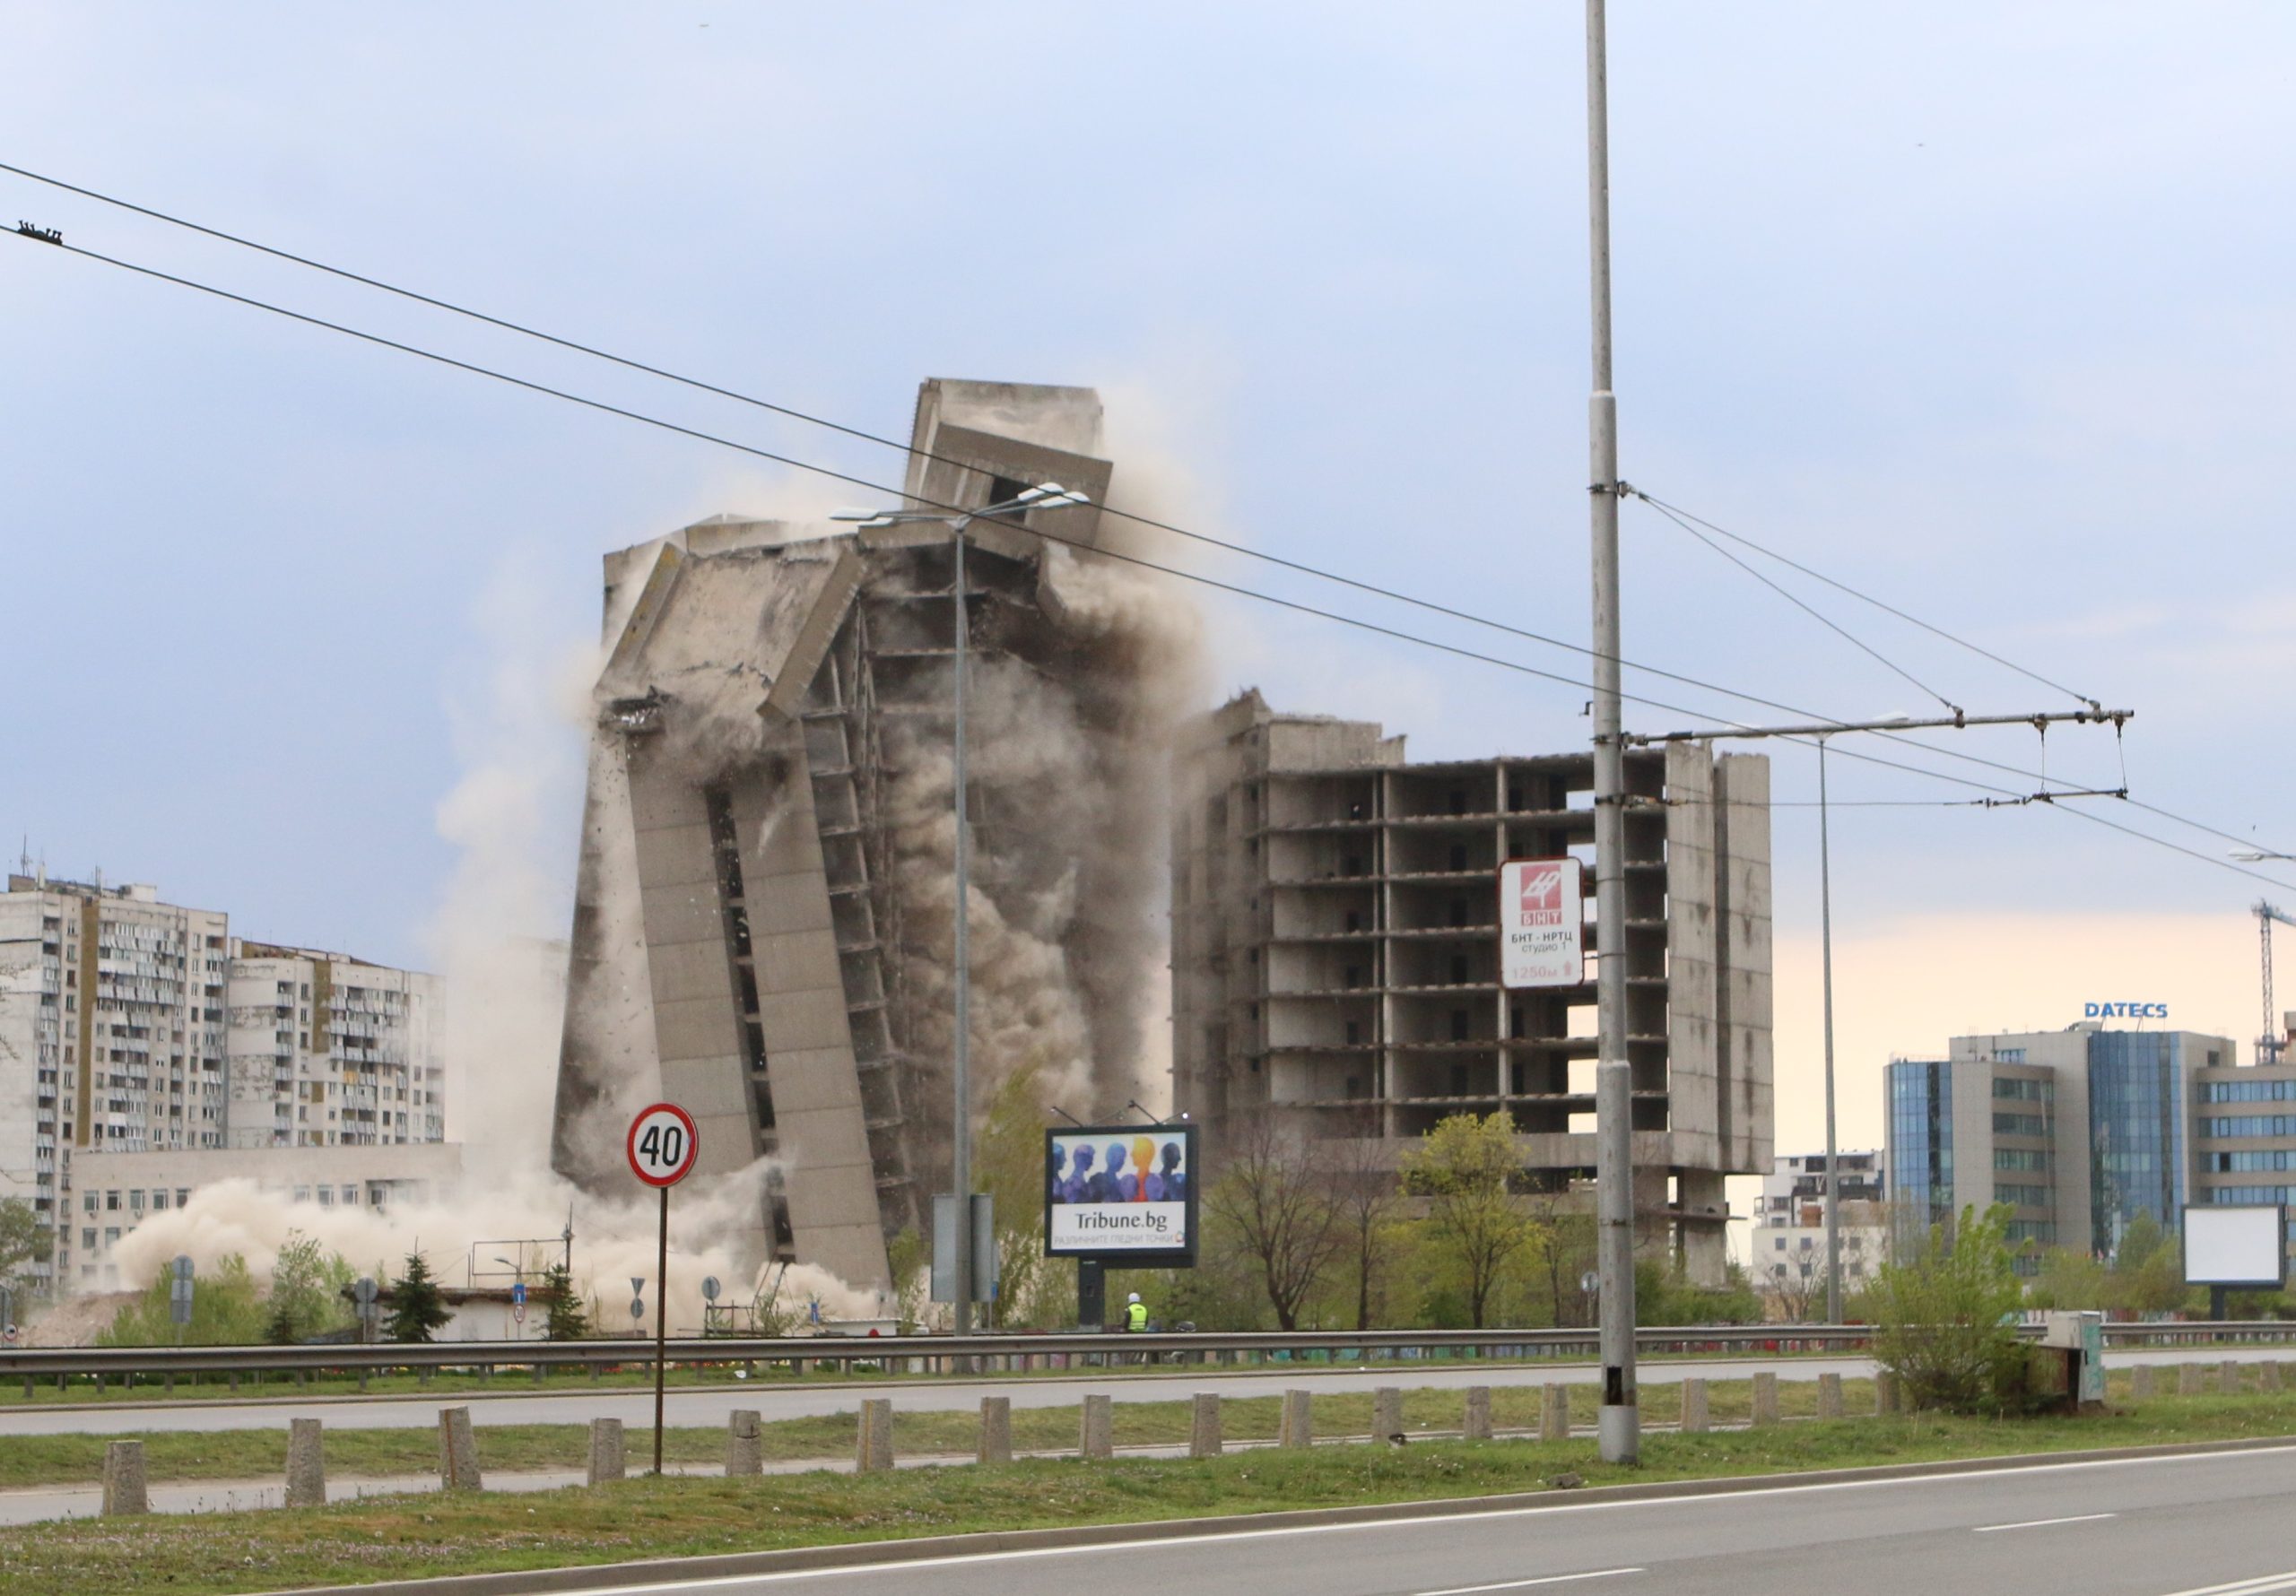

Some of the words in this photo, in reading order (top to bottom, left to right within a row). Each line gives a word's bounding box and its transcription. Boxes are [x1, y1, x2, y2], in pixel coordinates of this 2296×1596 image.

[1523, 913, 1561, 924] БНТ
[1511, 933, 1533, 943] БНТ
[1543, 932, 1573, 941] НРТЦ
[1522, 944, 1558, 954] студио
[2084, 1002, 2168, 1018] DATECS
[639, 1125, 682, 1167] 40
[1076, 1211, 1168, 1232] Tribune.bg
[1054, 1235, 1109, 1245] РАЗЛИЧНИТЕ
[1110, 1234, 1144, 1245] ГЛЕДНИ
[1145, 1233, 1173, 1244] ТОЧКИ
